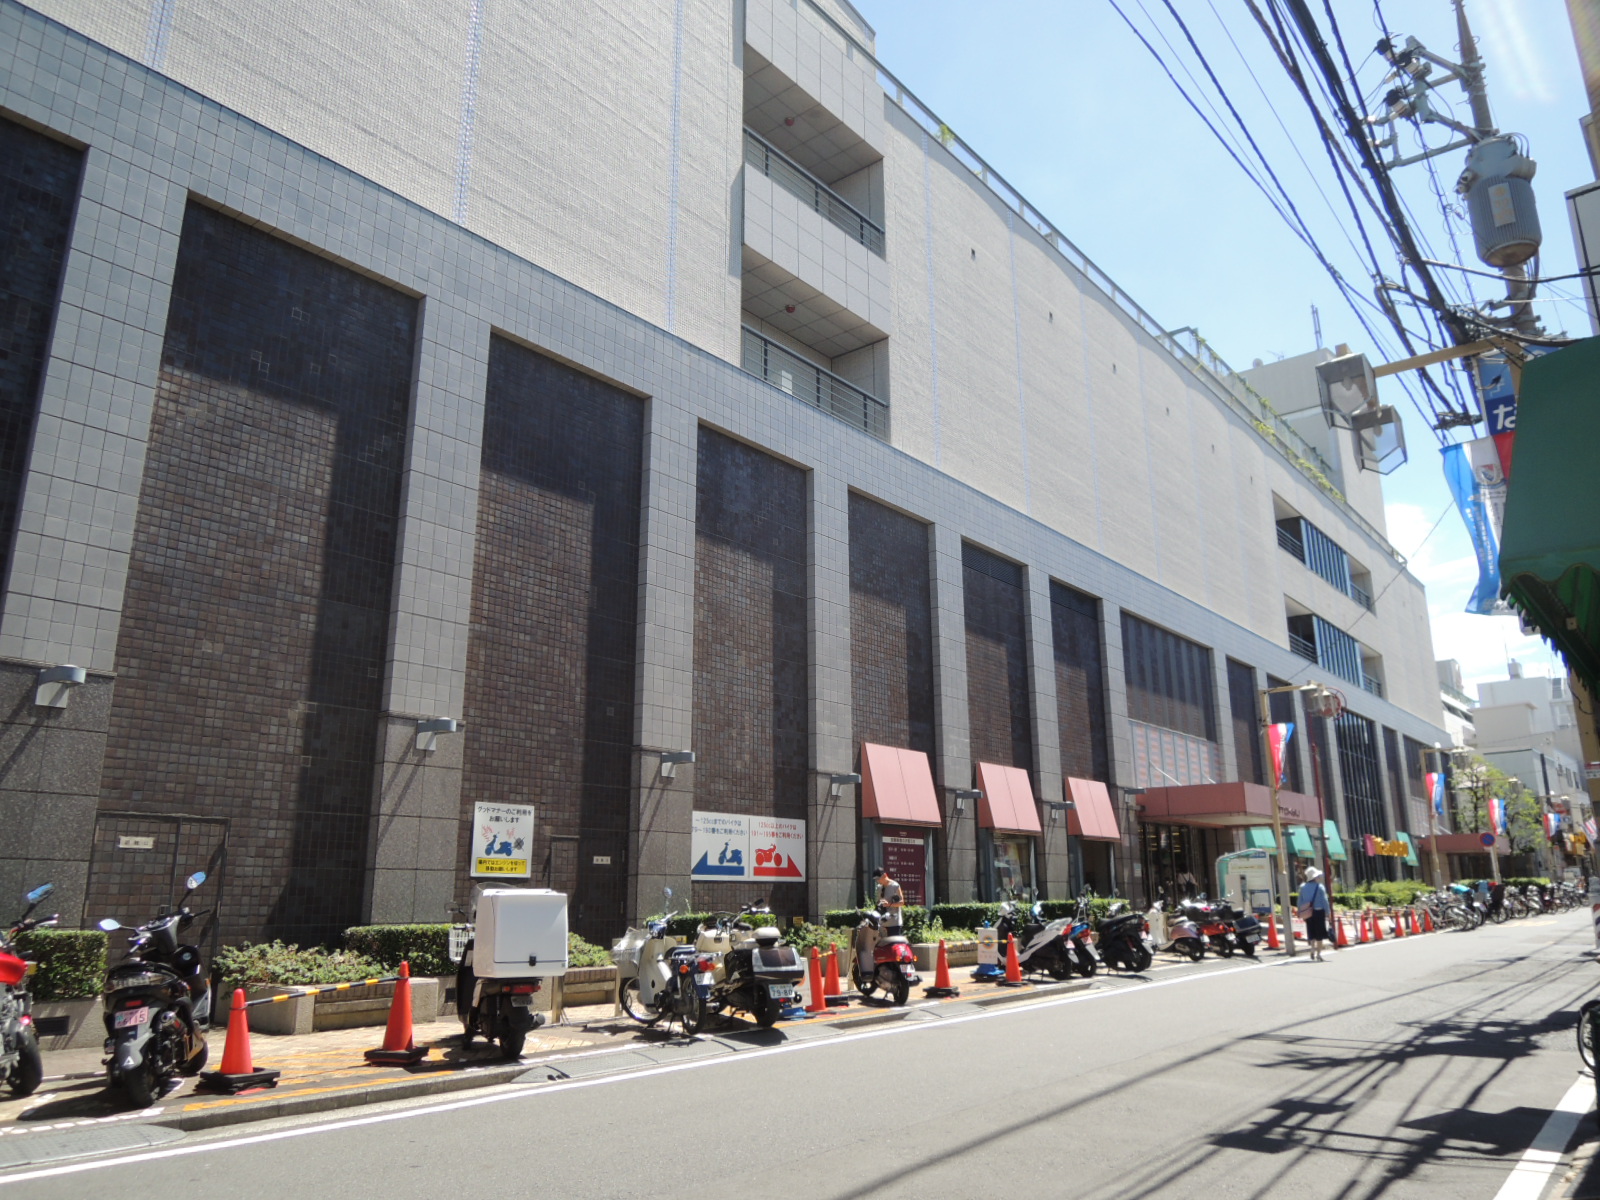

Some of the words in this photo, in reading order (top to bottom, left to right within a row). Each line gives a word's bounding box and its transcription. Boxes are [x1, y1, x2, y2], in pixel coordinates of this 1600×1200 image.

[477, 805, 532, 817] グッドマナーのご利用を
[489, 815, 520, 824] お願いします
